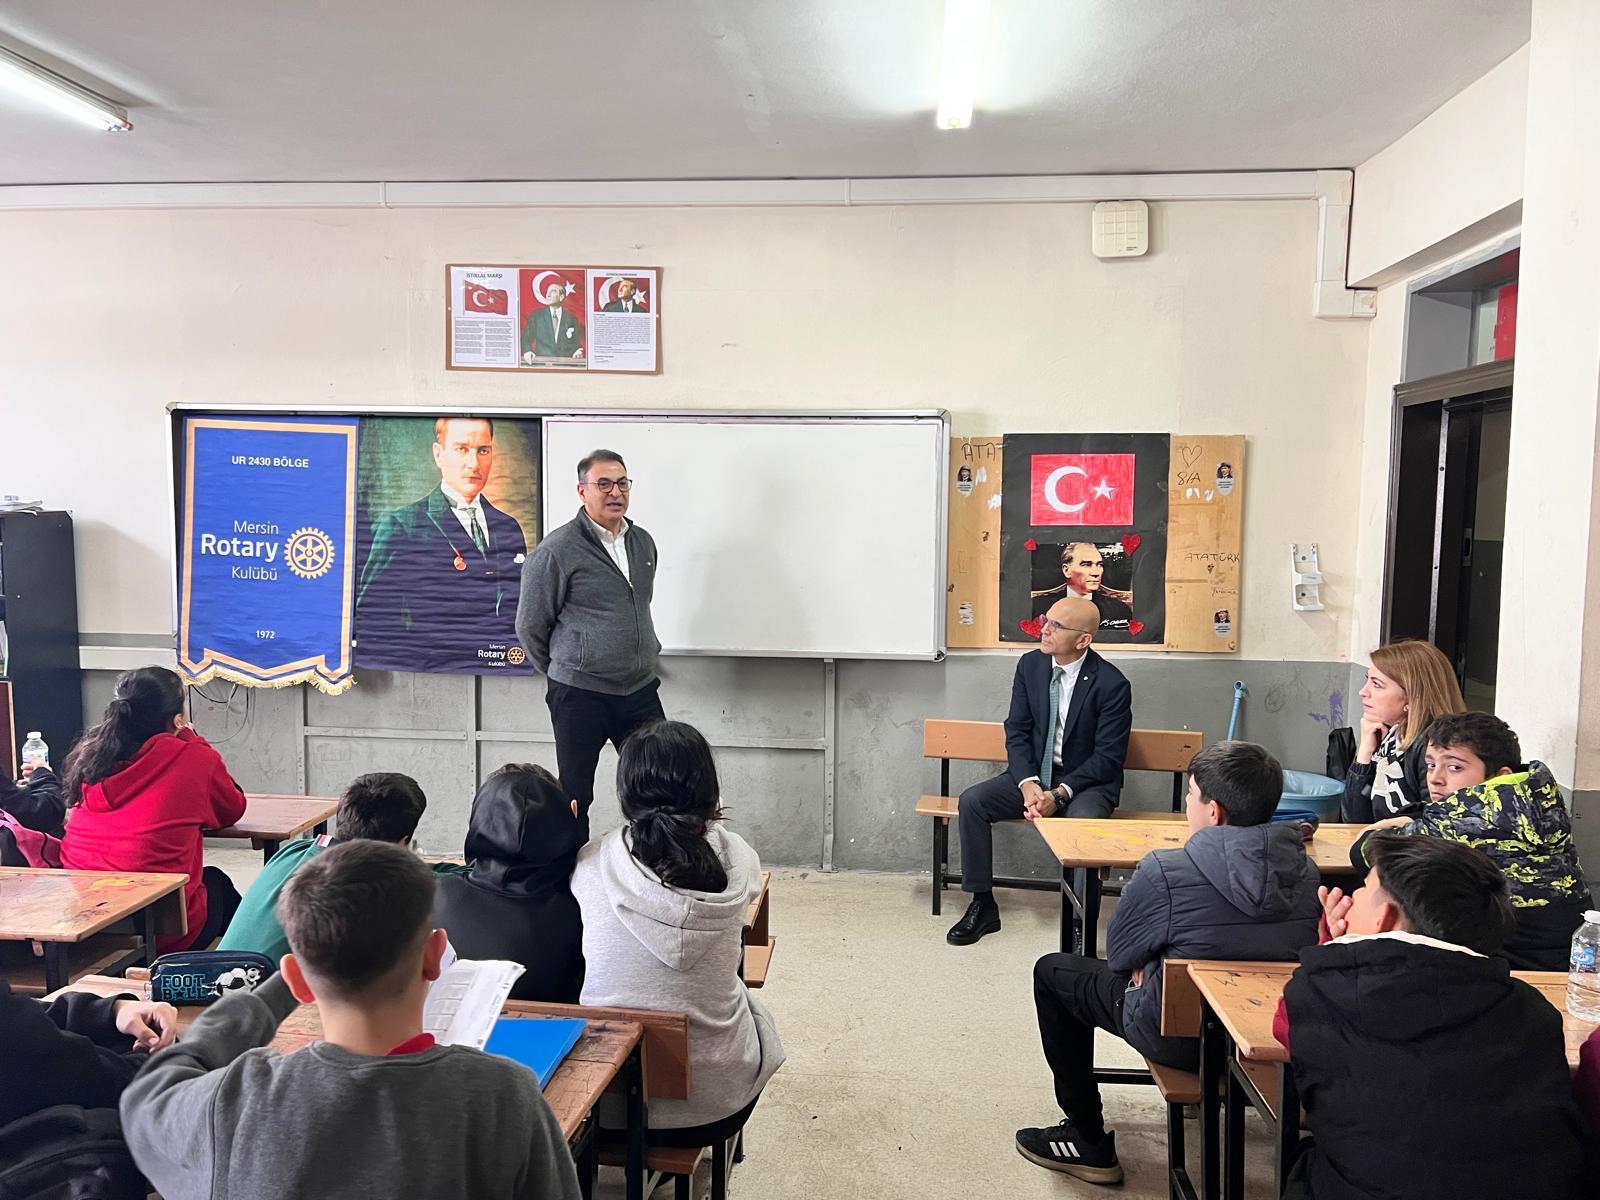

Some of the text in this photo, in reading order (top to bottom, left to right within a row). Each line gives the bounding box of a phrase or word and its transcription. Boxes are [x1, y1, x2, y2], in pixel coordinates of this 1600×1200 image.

[961, 442, 1003, 462] ATA
[231, 455, 309, 468] UR 2430 BÖLGE
[233, 520, 279, 535] Mersin
[200, 533, 279, 562] Rotary
[231, 566, 278, 581] Kulübü
[255, 630, 276, 639] 1972
[477, 649, 506, 660] Rotary
[161, 973, 207, 988] FOOT
